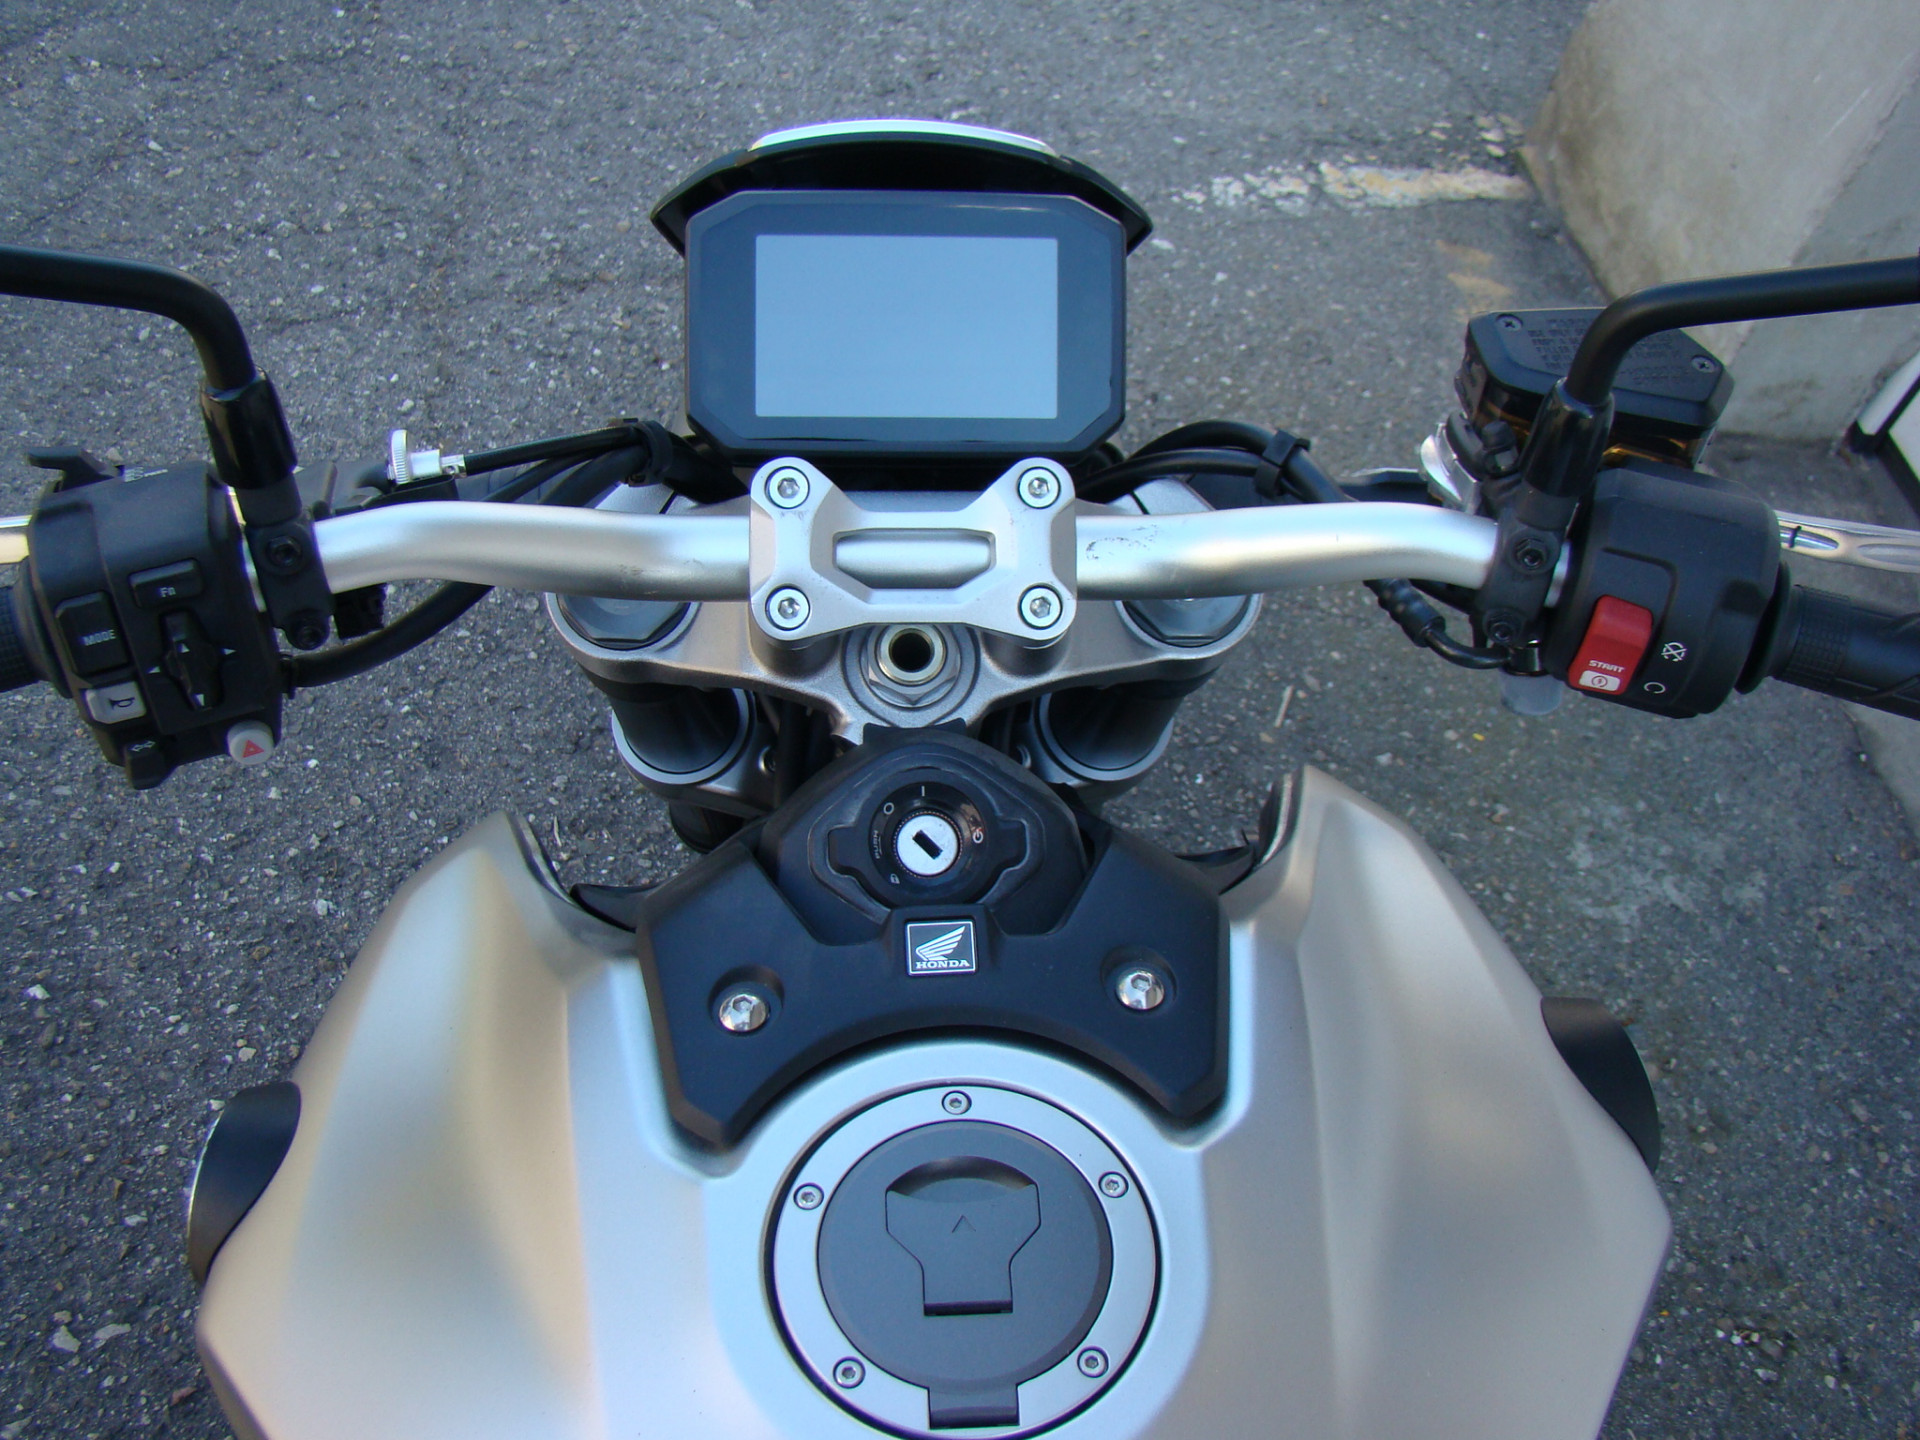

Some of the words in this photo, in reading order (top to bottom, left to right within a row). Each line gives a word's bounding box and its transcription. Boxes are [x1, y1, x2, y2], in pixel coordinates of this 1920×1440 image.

[160, 587, 176, 597] Fn
[83, 629, 115, 646] MODE
[1589, 660, 1624, 672] START
[872, 829, 881, 859] PUSH
[915, 959, 970, 969] HONDA
